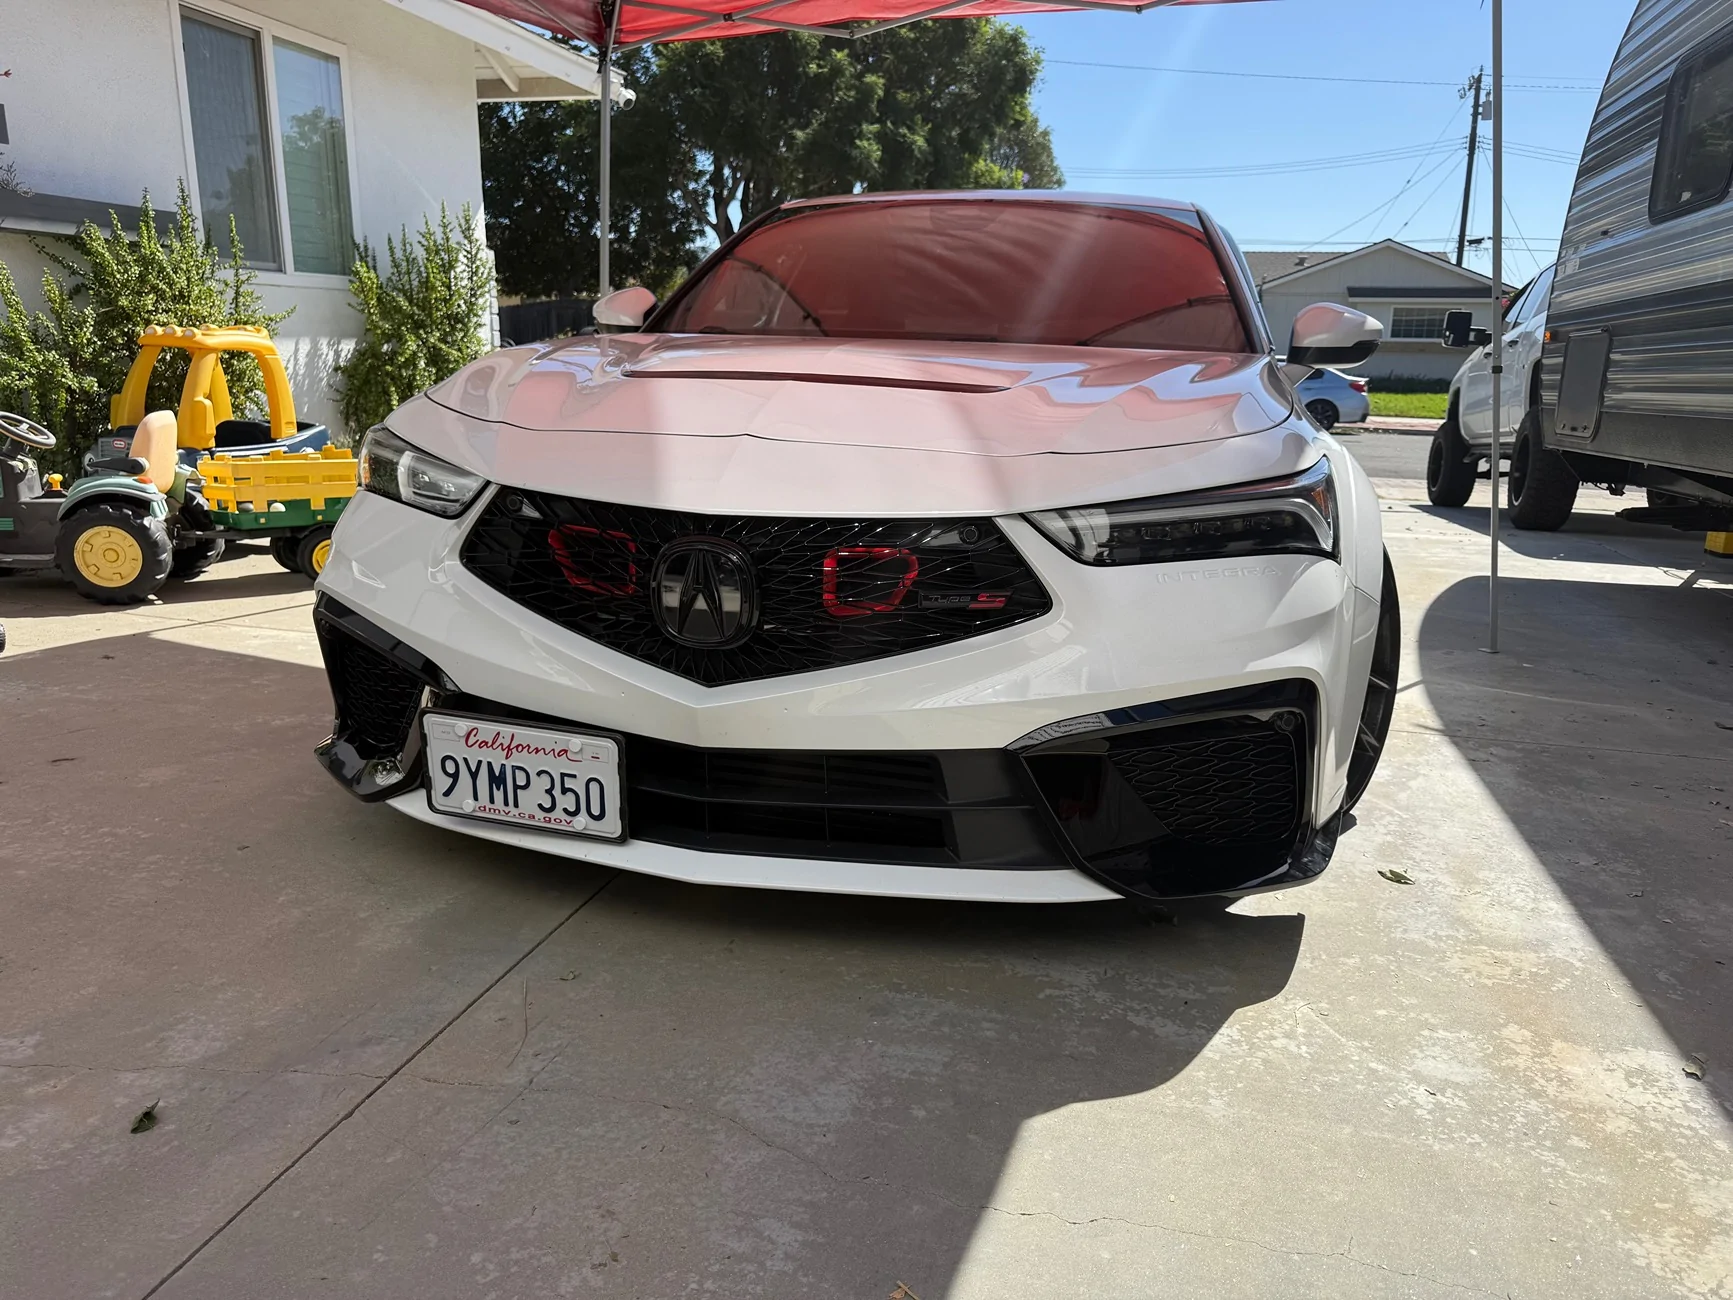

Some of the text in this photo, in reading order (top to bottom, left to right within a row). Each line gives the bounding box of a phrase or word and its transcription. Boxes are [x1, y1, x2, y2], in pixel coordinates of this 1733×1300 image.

[1156, 564, 1278, 584] INTEGRA
[968, 593, 1006, 609] S
[464, 727, 583, 762] California
[440, 754, 606, 821] 9YMP350
[477, 804, 574, 826] dmv.ca.gov
